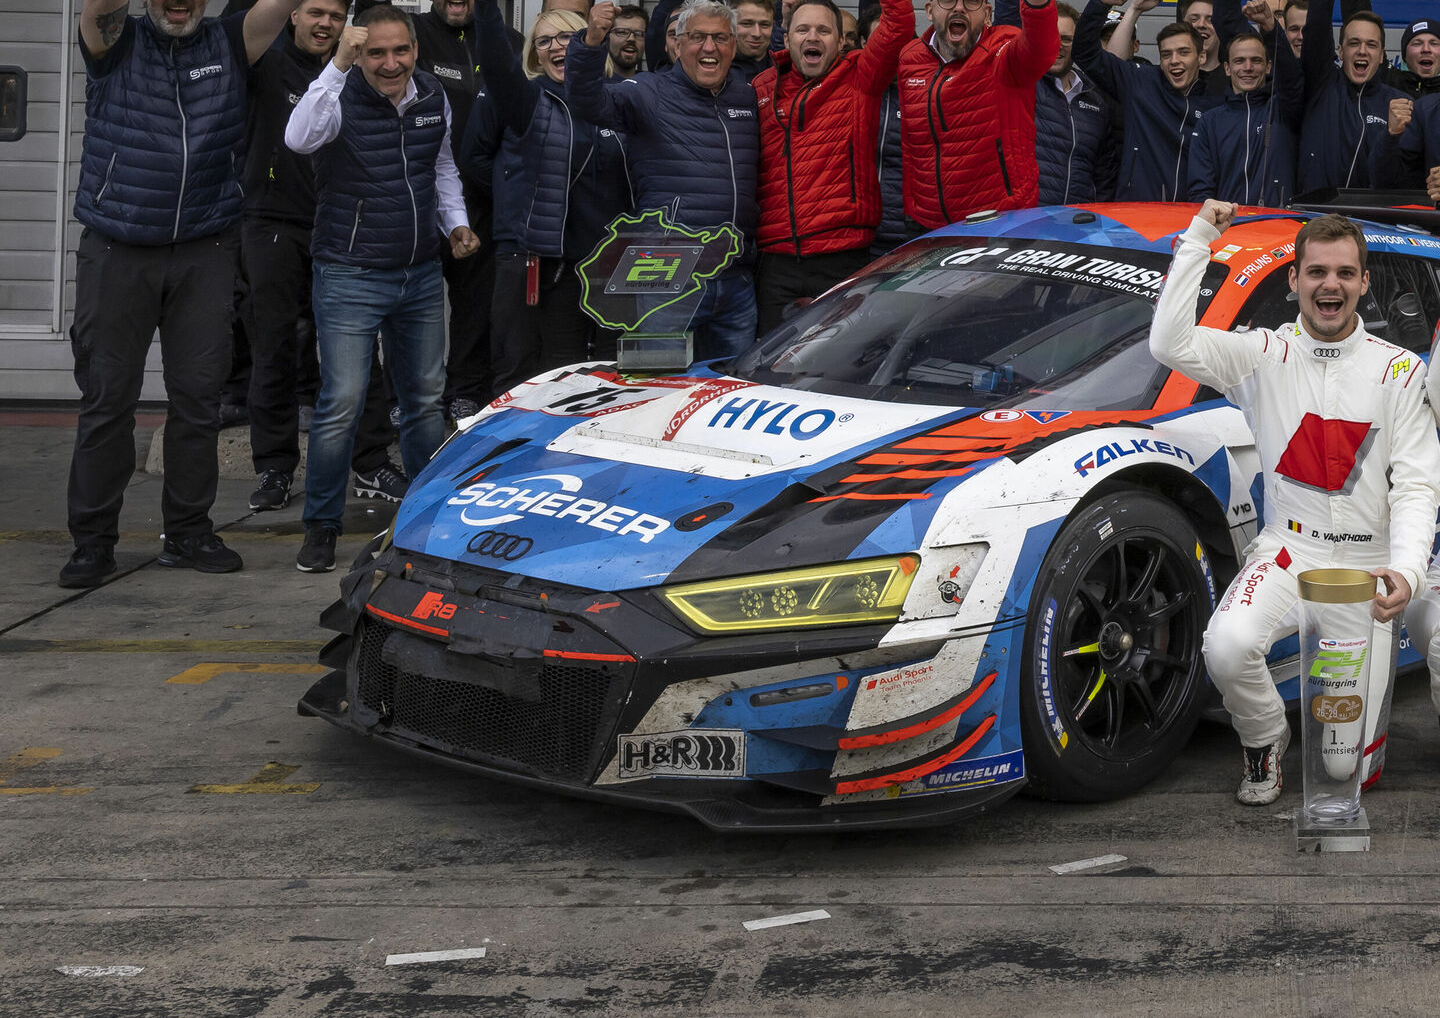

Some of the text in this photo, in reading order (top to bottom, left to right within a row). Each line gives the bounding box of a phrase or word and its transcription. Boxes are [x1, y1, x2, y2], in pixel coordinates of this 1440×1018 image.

[1364, 233, 1406, 246] ANTHOOR
[1004, 249, 1166, 290] GRAN TURIS
[1241, 254, 1273, 278] FRIJNS
[996, 263, 1159, 300] THE REAL DRIVING SIMULAT
[1391, 357, 1411, 380] P1
[707, 396, 836, 441] HYLO
[1074, 438, 1196, 478] FALKEN
[448, 481, 671, 544] SCHERER
[1232, 502, 1252, 517] V10
[1311, 530, 1320, 539] D.
[1220, 582, 1240, 612] racing
[1240, 572, 1264, 606] Sport
[428, 600, 458, 620] R8
[1040, 606, 1055, 717] MICHELIN
[879, 665, 934, 686] Audi Sport
[881, 675, 933, 693] Team Phoenix
[1308, 677, 1357, 689] nürburgring
[1330, 730, 1344, 745] 1.
[624, 735, 697, 772] H&R
[928, 762, 1012, 785] MICHELIN
